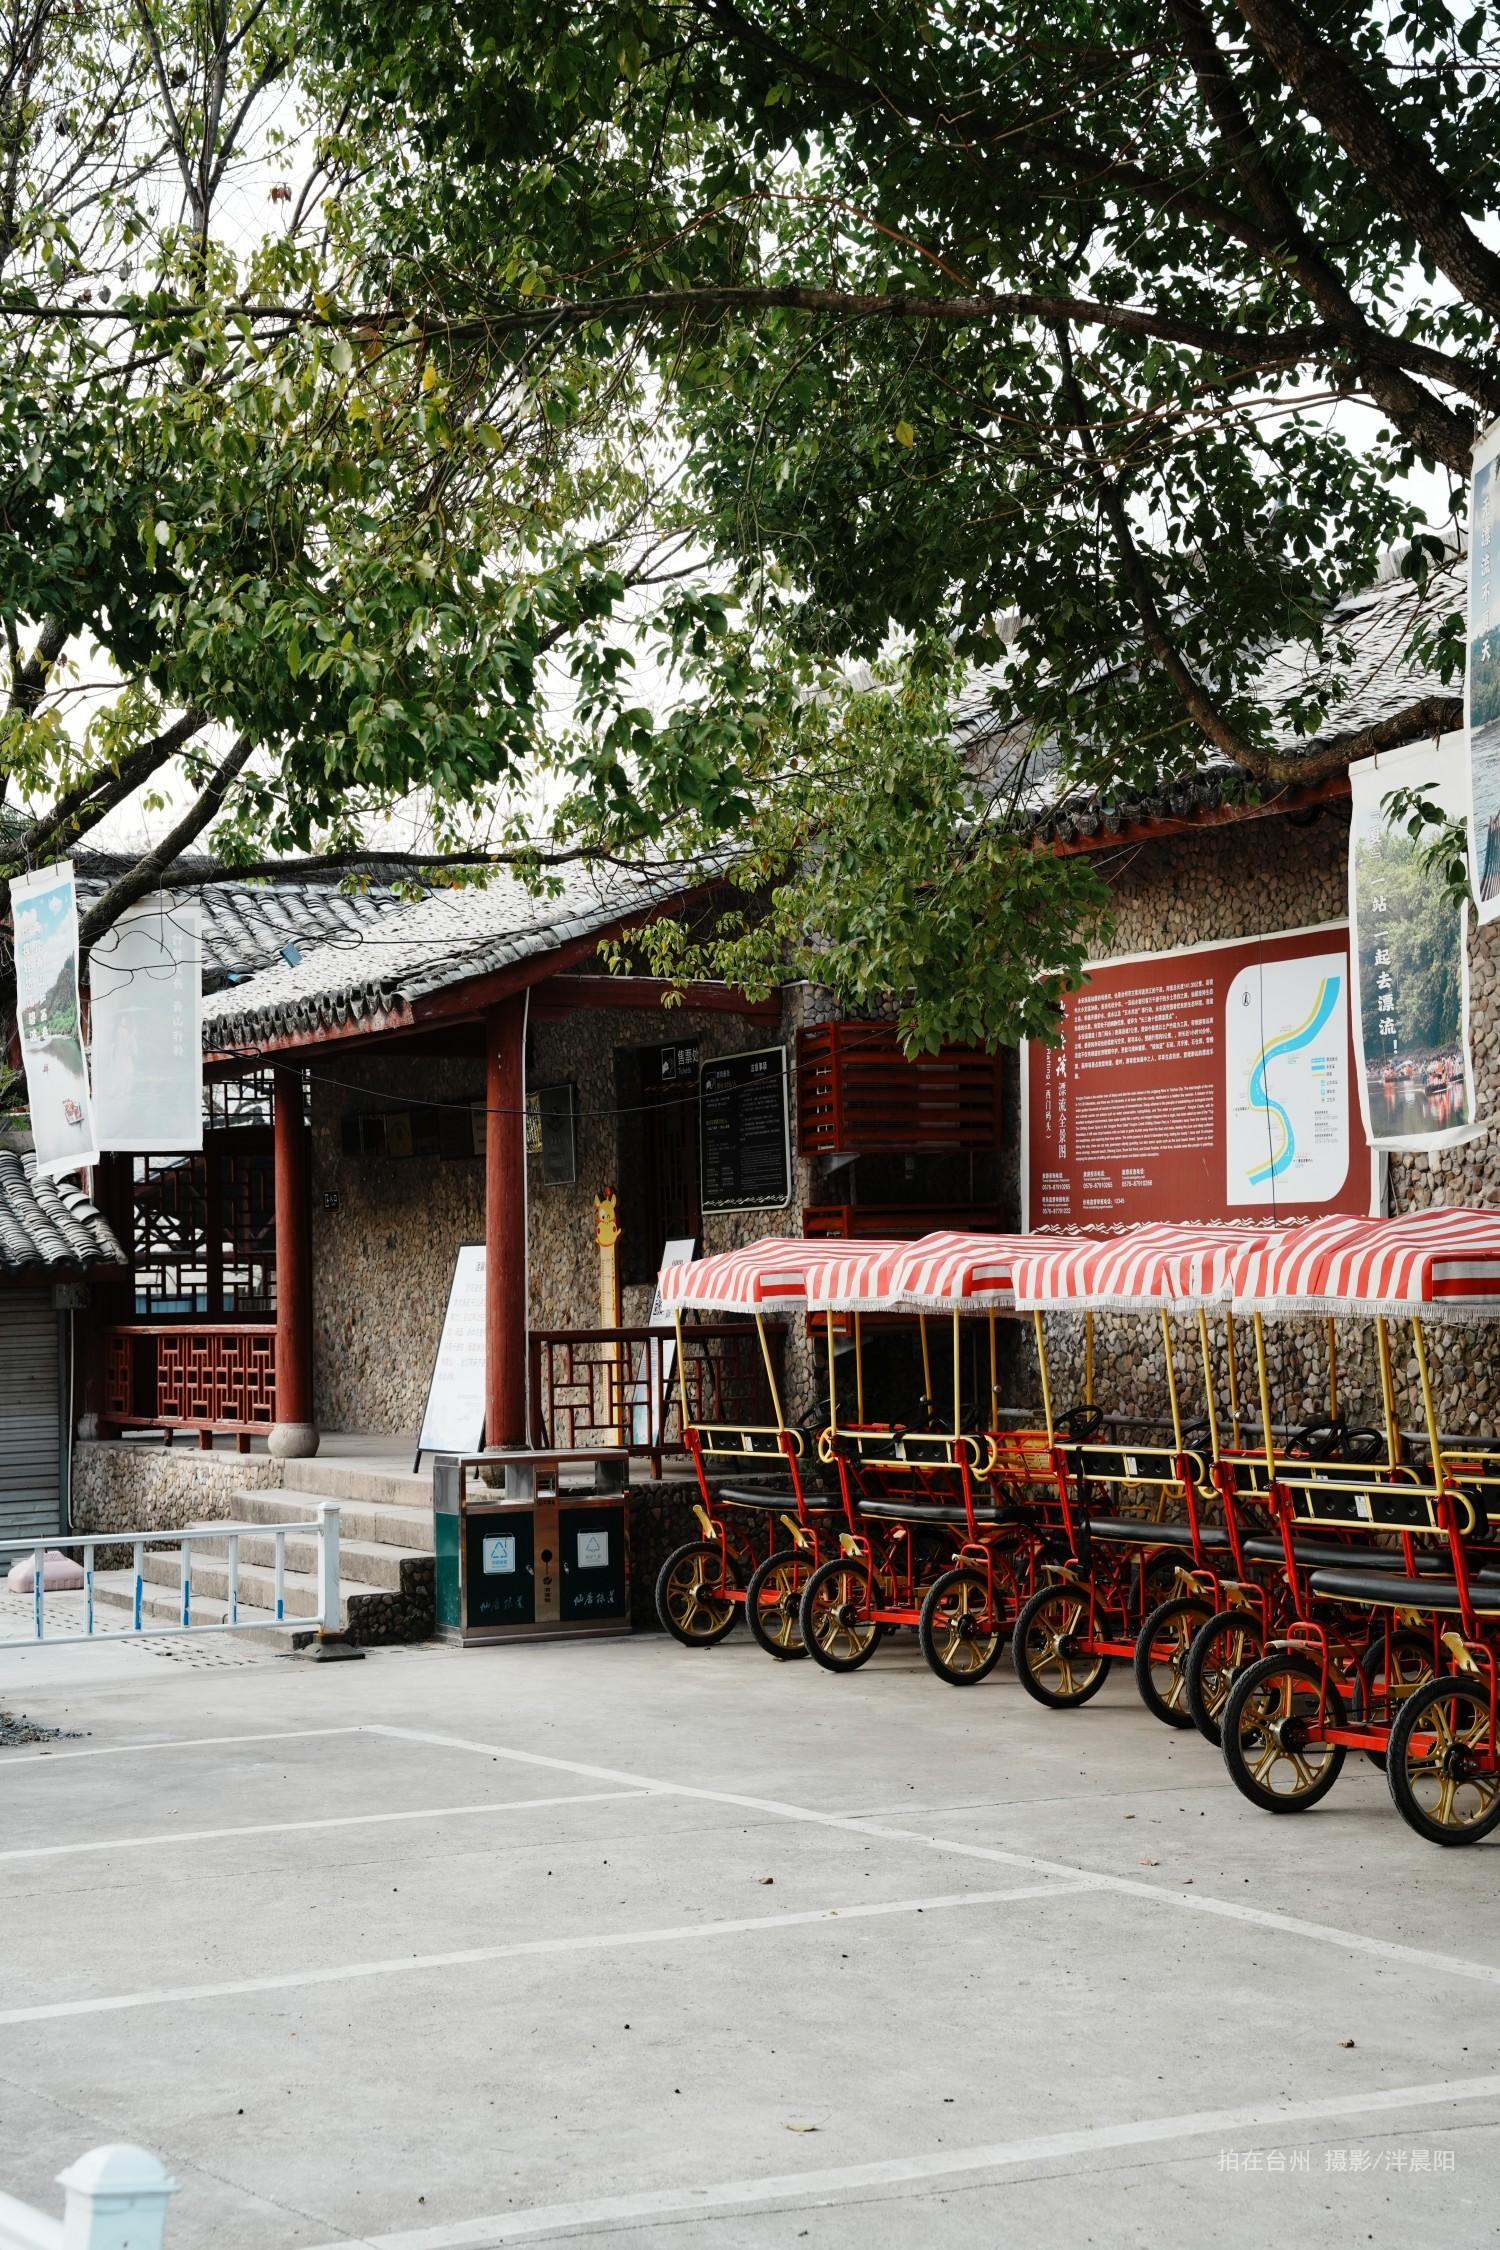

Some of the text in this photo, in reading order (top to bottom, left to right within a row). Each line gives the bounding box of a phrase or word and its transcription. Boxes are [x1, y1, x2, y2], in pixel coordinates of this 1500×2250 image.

[1481, 498, 1492, 663] 无漂流不夏天
